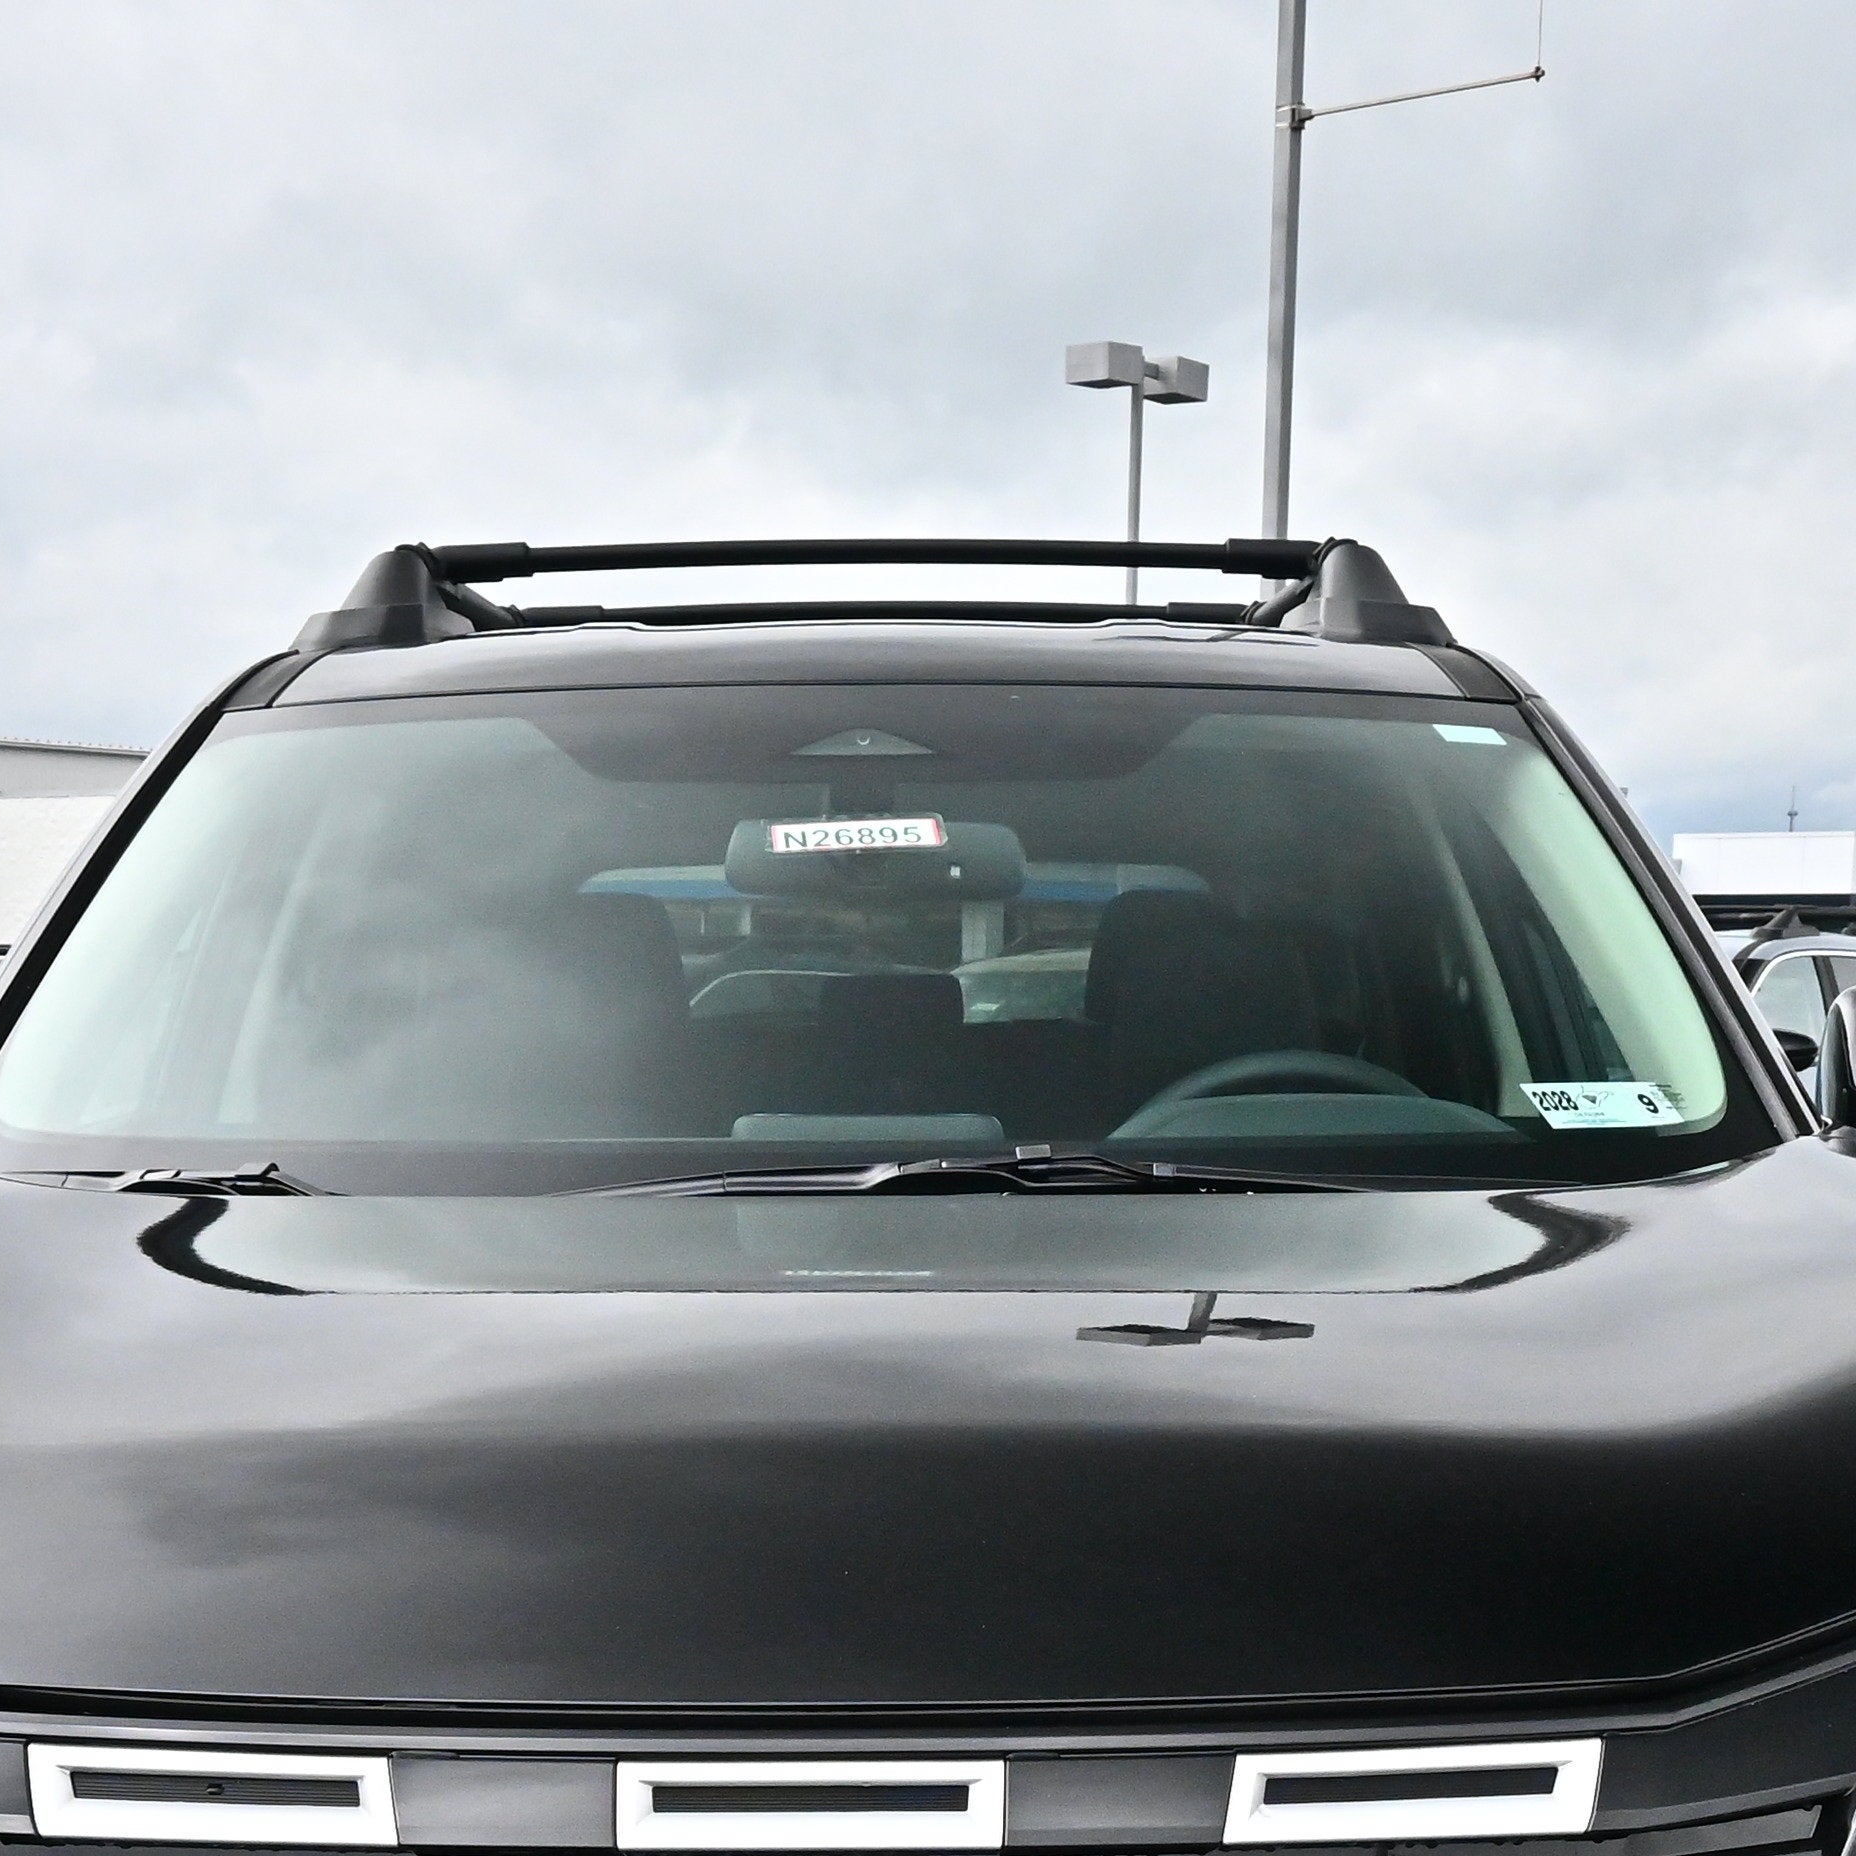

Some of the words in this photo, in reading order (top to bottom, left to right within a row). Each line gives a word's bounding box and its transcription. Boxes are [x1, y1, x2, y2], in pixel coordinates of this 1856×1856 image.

[783, 826, 922, 848] N26895
[1531, 1090, 1579, 1112] 2028
[1637, 1093, 1659, 1114] 9
